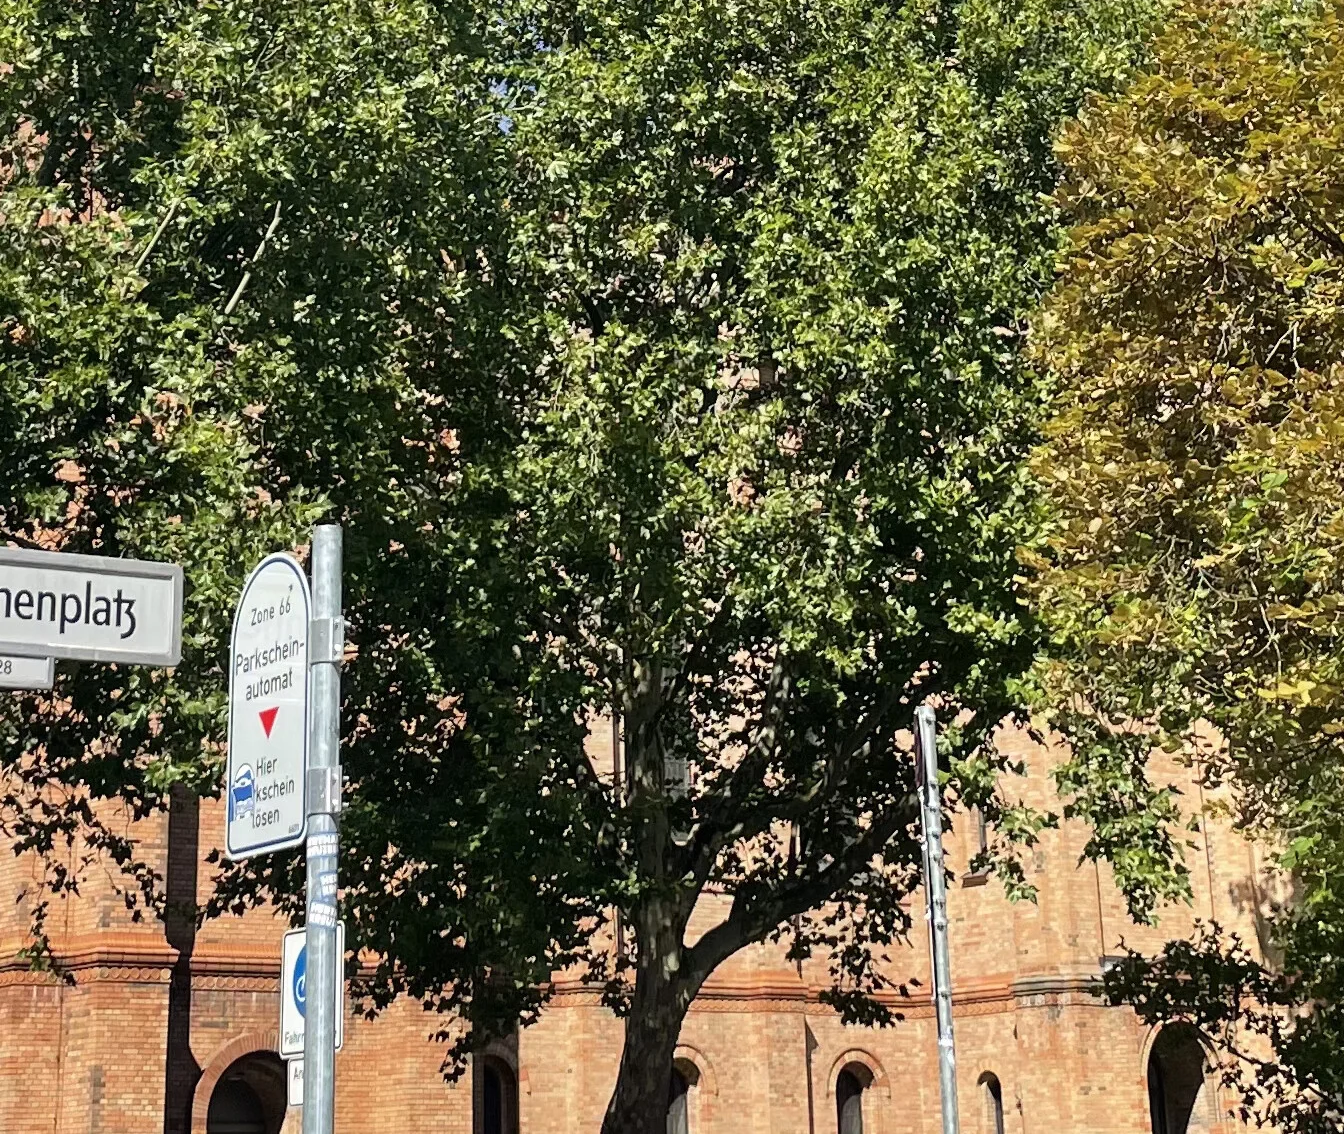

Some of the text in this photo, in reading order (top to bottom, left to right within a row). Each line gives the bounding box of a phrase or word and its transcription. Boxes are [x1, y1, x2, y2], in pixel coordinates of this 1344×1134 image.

[250, 595, 291, 626] Zone 66
[235, 635, 305, 677] Parkschein-
[245, 667, 293, 701] automat
[256, 756, 277, 777] Hier
[256, 775, 295, 803] kschein
